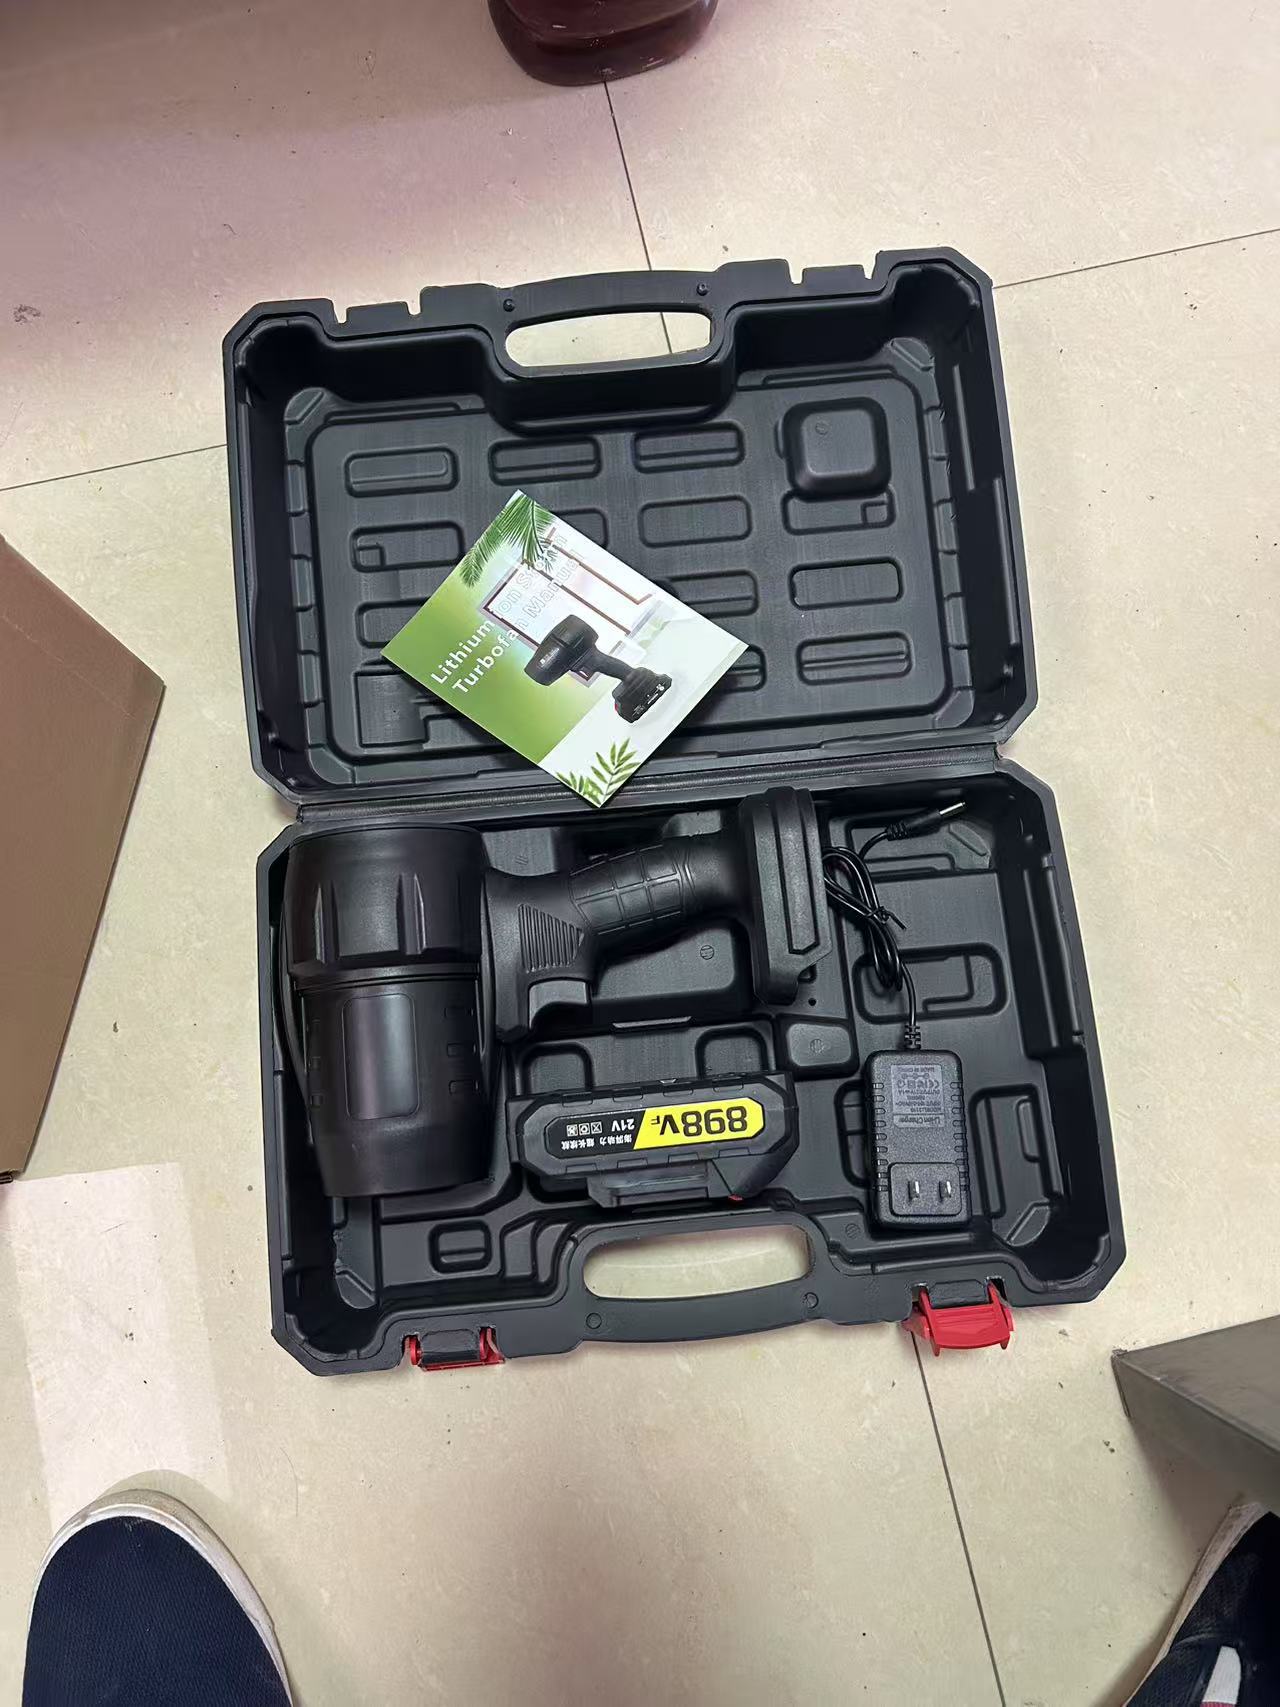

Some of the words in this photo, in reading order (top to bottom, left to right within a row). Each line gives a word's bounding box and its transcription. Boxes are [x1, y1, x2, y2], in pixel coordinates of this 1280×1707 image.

[430, 619, 496, 686] Lithium
[452, 610, 529, 694] Turbofan
[522, 548, 585, 619] Manual
[611, 1118, 635, 1132] 21V
